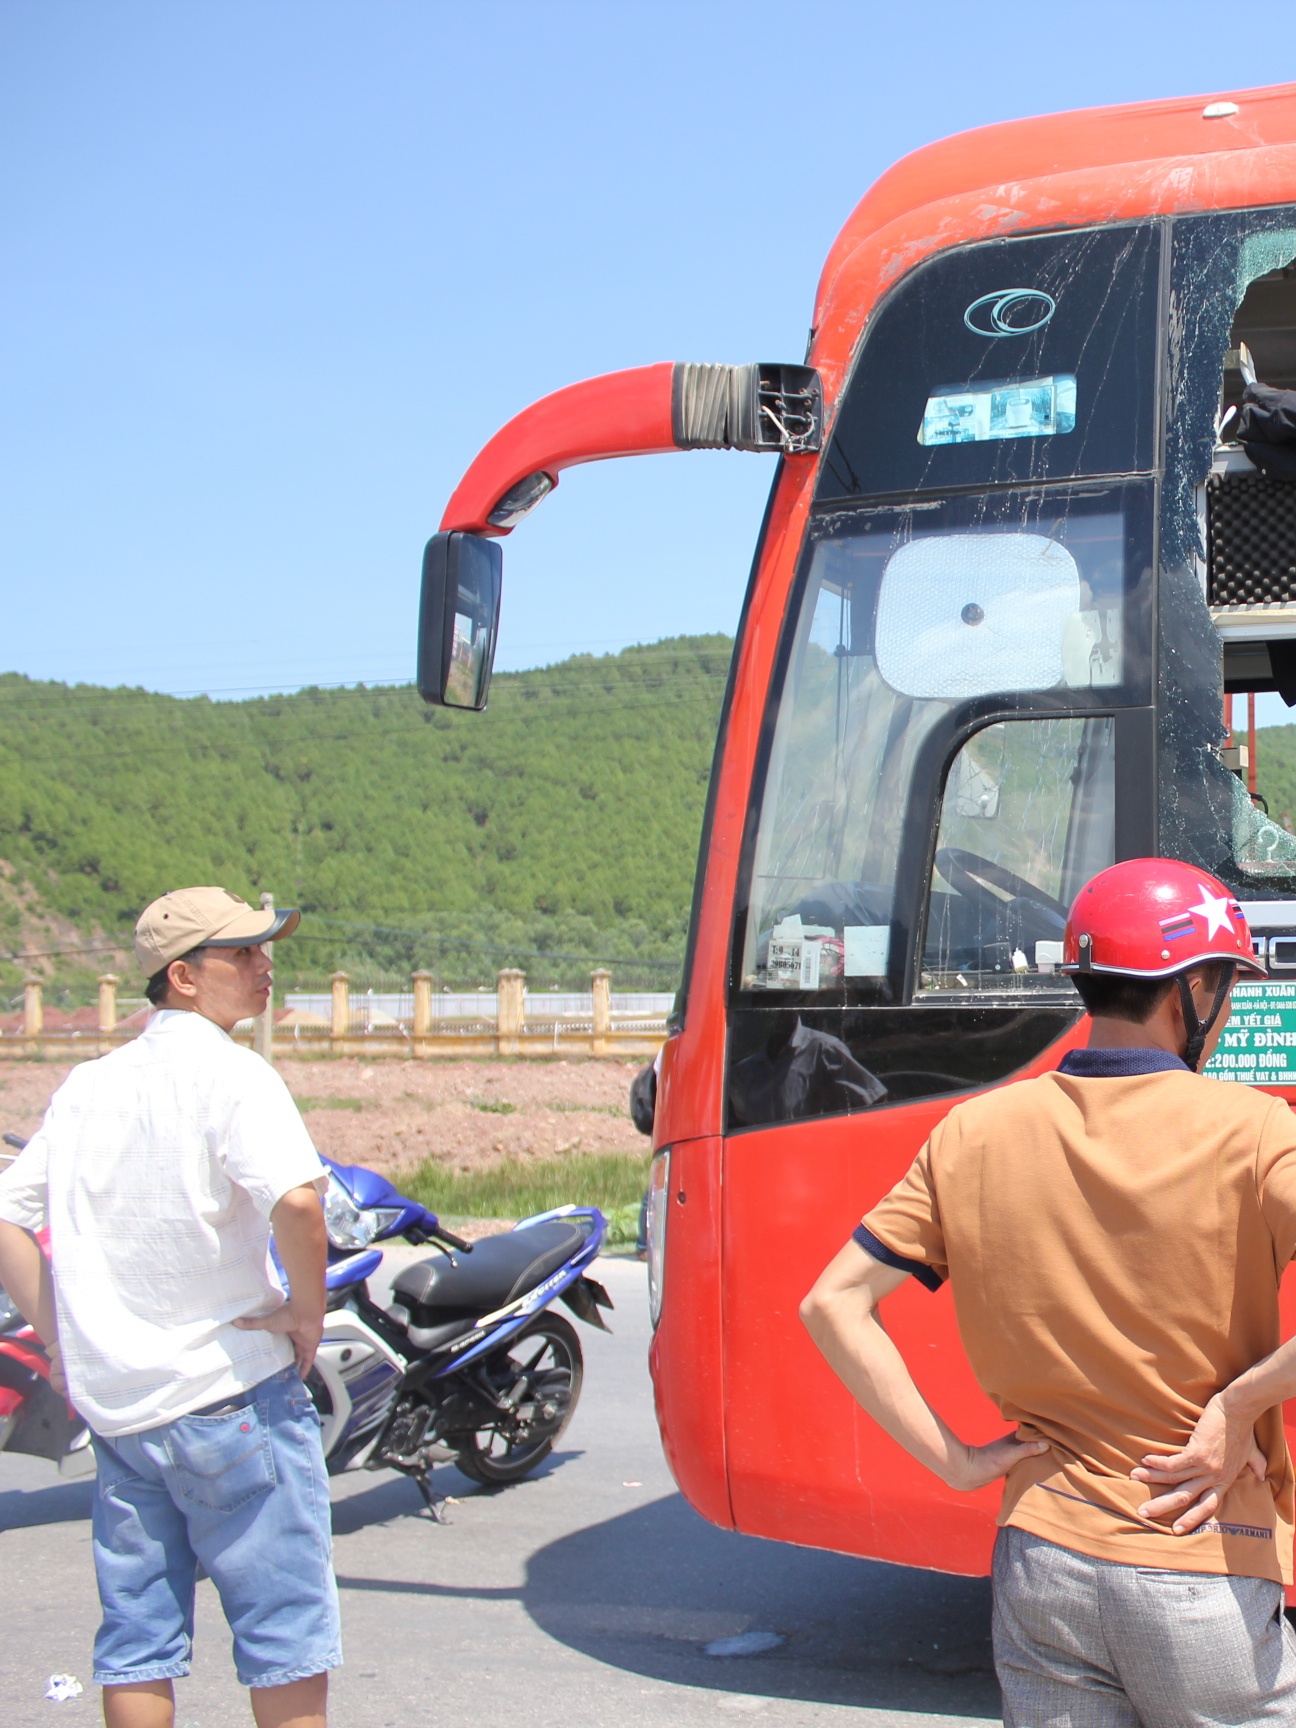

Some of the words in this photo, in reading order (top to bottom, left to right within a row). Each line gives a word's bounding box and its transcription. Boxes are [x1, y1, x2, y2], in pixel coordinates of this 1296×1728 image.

[1230, 986, 1263, 998] HANH
[1265, 984, 1296, 997] XUÂN
[1243, 1012, 1262, 1026] YẾT
[1264, 1012, 1282, 1026] GIÁ
[1224, 1029, 1250, 1047] MỸ
[1259, 1049, 1287, 1068] ĐỒNG
[1236, 1068, 1255, 1081] THUẾ
[1255, 1071, 1270, 1081] VAT
[1270, 1071, 1277, 1081] &
[1239, 1527, 1268, 1539] ARMANI
